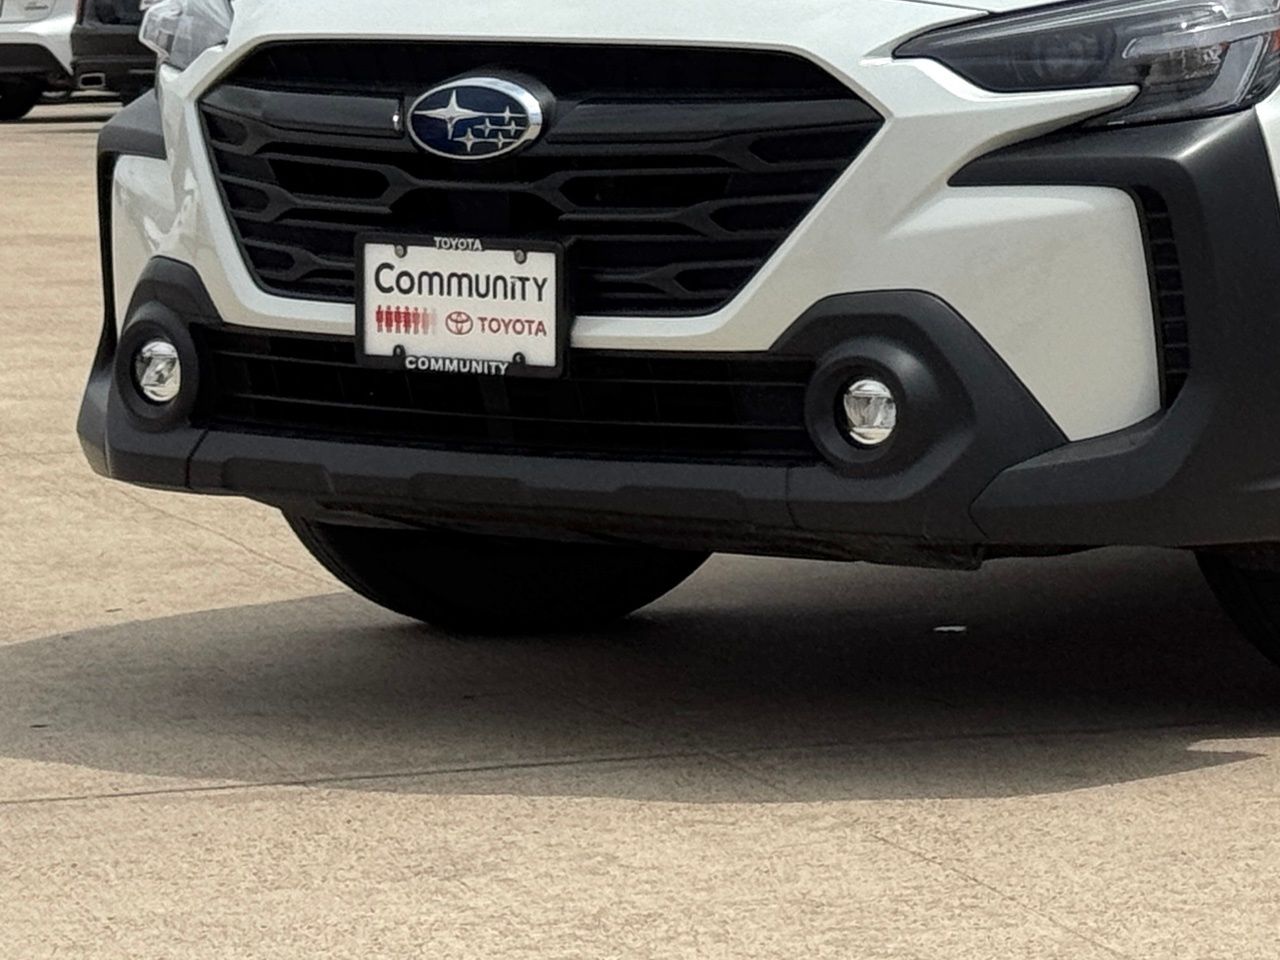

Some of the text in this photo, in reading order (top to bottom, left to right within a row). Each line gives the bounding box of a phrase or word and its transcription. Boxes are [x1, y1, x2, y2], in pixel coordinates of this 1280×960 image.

[433, 236, 483, 251] TOYOTA
[477, 317, 547, 336] TOYOTA
[405, 356, 509, 376] COMMUNITY
